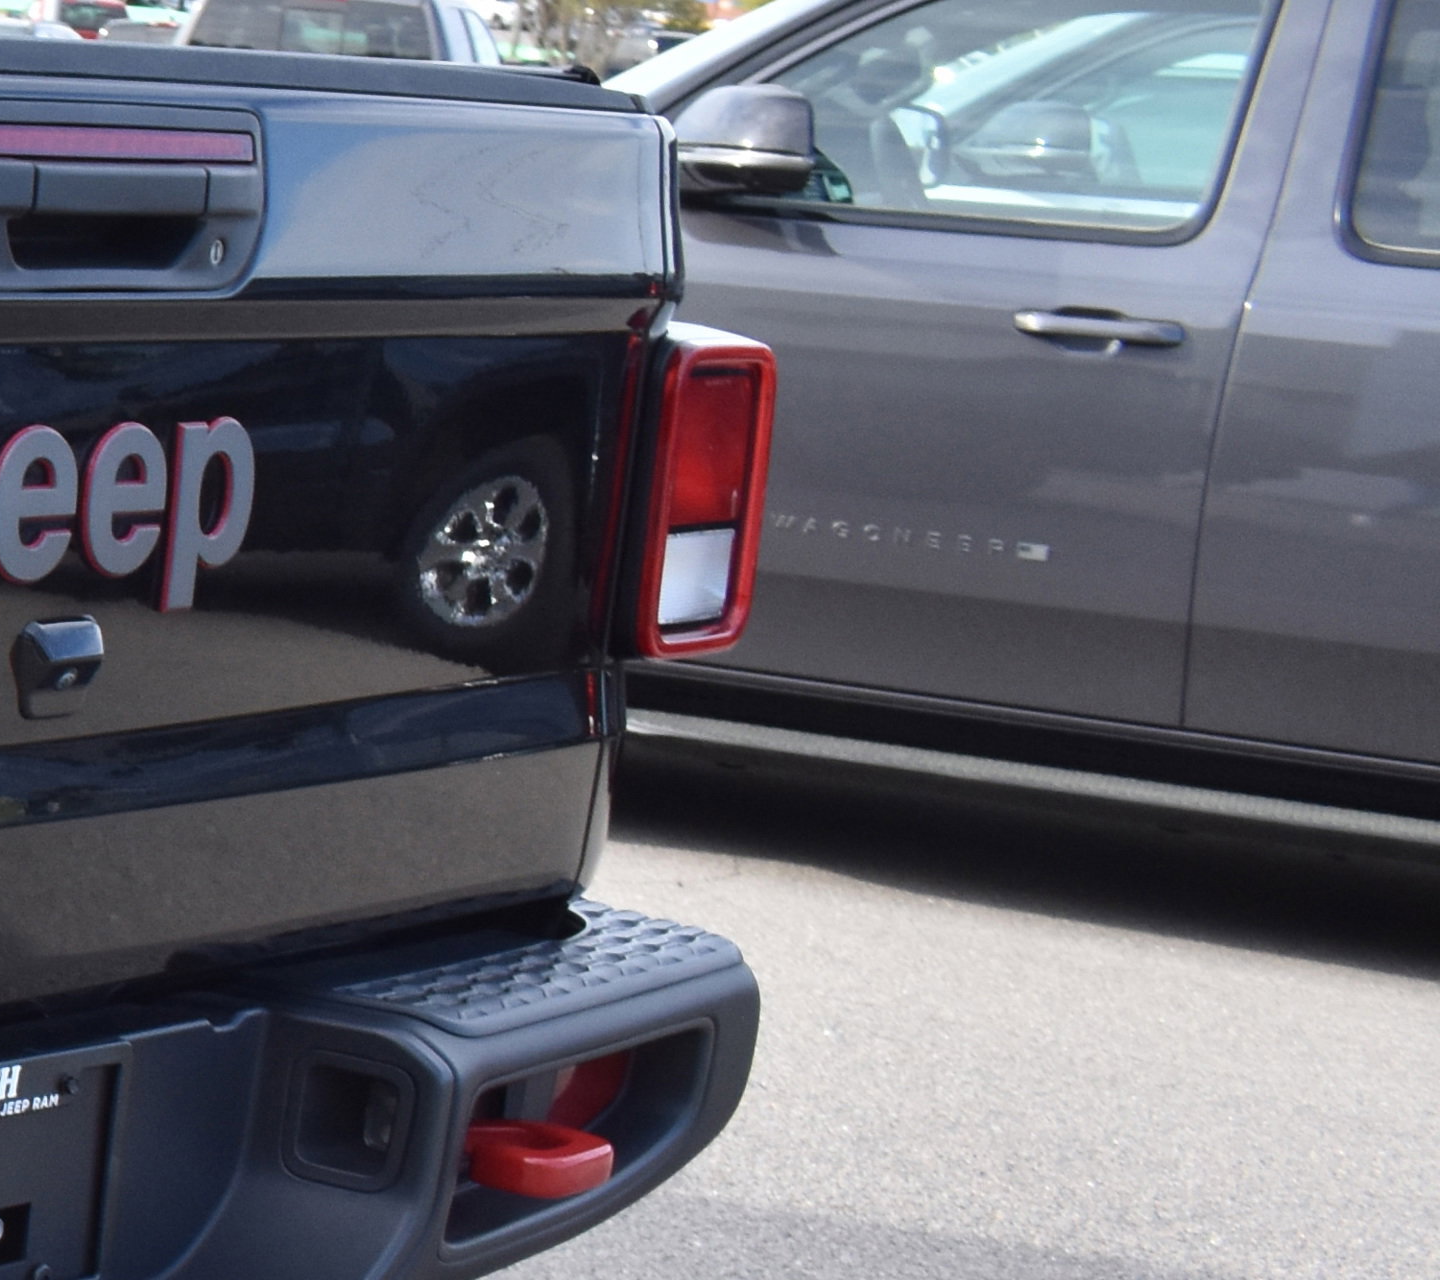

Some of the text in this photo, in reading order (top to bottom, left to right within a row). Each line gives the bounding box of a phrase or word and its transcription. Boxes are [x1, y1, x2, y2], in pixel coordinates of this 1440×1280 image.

[770, 513, 1005, 554] WAGONEER
[0, 1098, 30, 1116] JEEP
[32, 1093, 60, 1111] RAM
